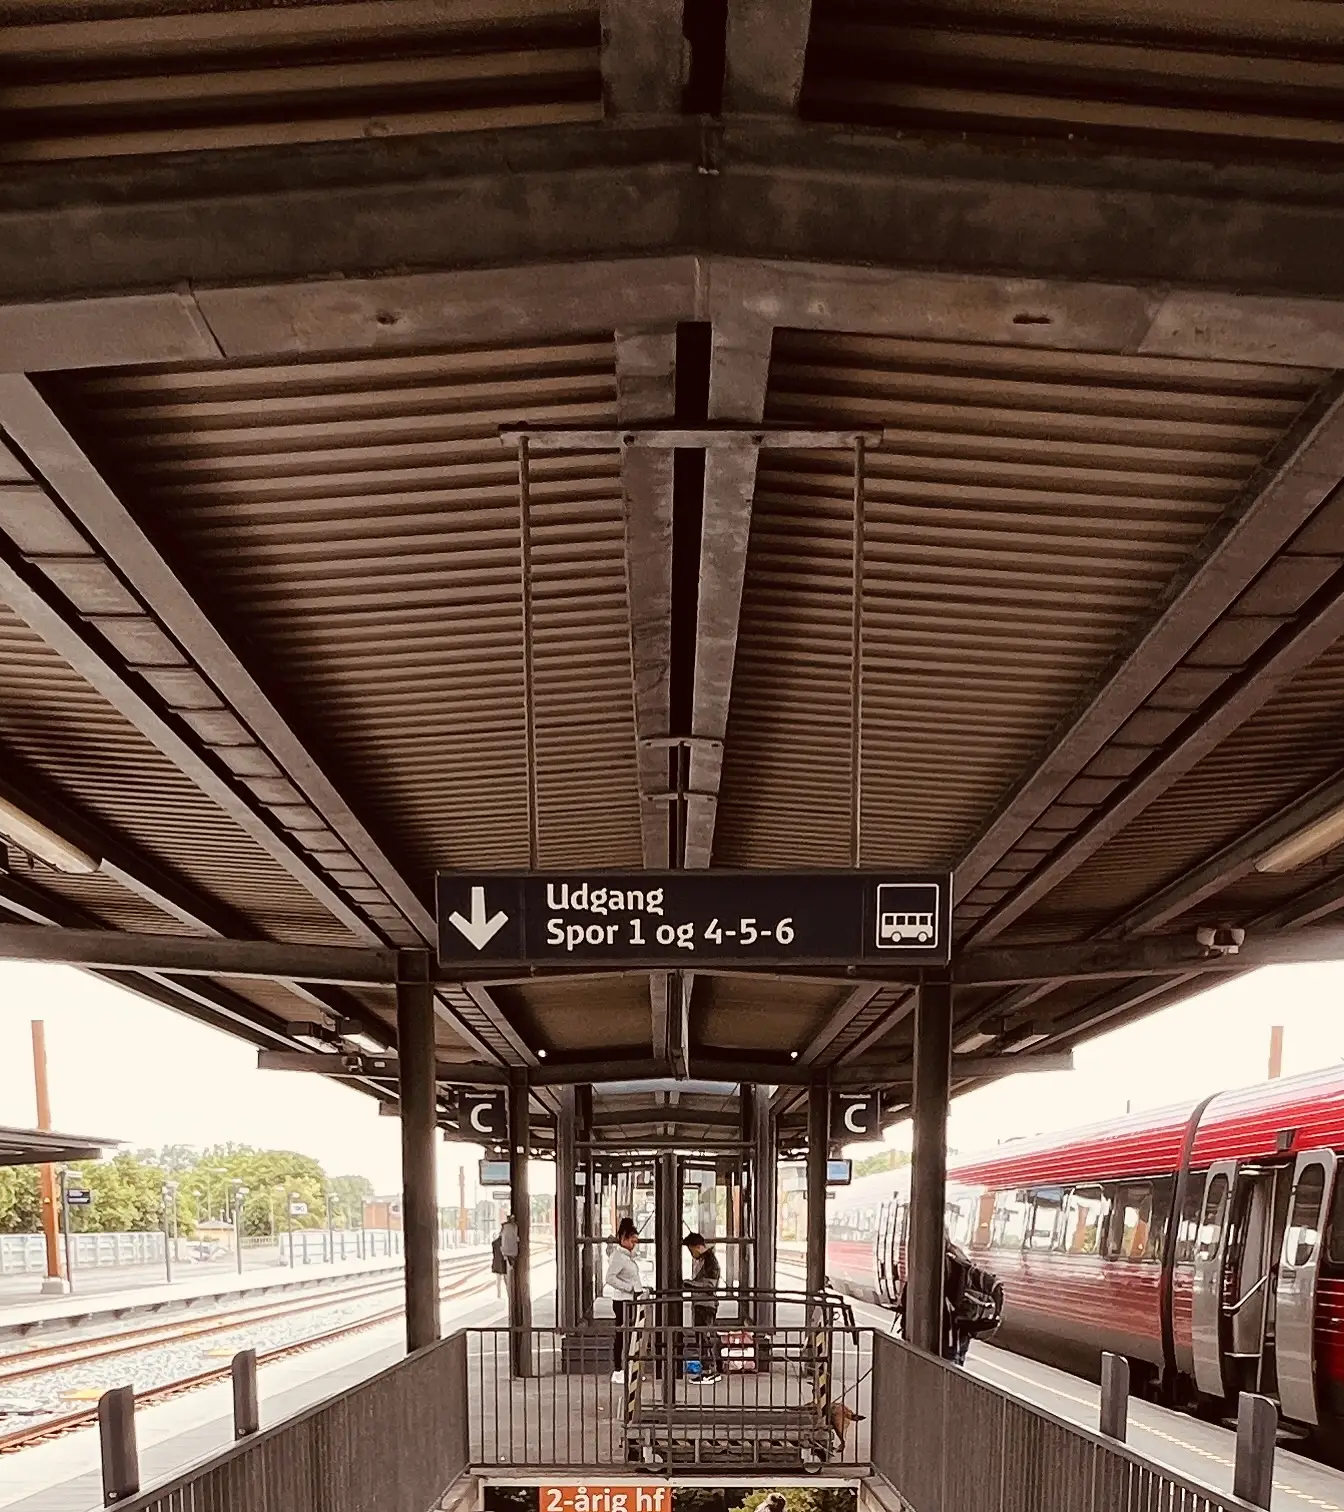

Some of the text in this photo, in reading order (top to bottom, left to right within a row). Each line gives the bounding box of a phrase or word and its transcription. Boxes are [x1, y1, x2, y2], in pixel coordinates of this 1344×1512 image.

[546, 883, 664, 915] Udgang
[546, 917, 795, 951] Spor 1 og 4-5-6
[470, 1103, 493, 1133] C
[844, 1103, 867, 1133] C
[636, 1487, 666, 1512] hf
